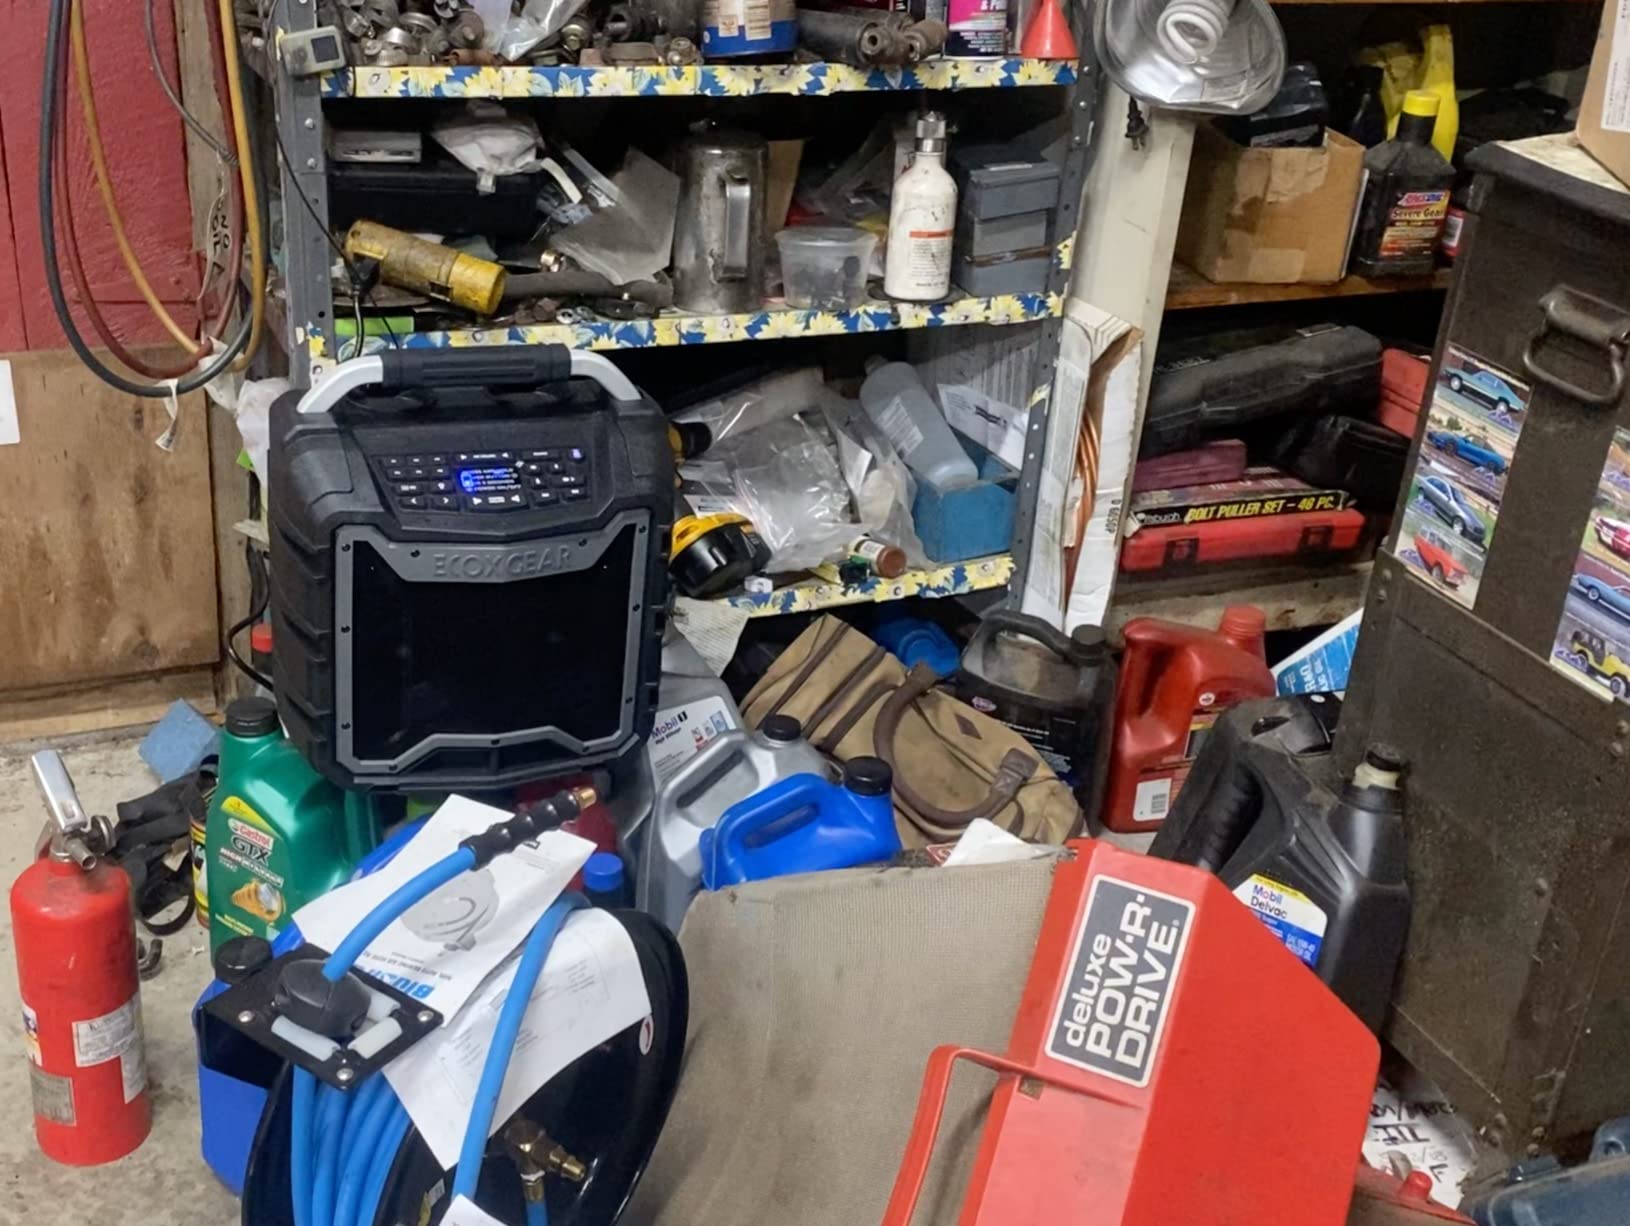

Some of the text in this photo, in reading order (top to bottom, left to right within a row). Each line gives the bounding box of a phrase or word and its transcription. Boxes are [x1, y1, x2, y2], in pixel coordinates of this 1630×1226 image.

[1392, 207, 1421, 219] Severe
[1184, 506, 1216, 524] BOLT
[1216, 501, 1260, 519] PULLER
[1261, 499, 1287, 514] SET
[432, 545, 572, 578] ECOXGEAR
[654, 715, 679, 738] Mobil
[238, 822, 272, 850] Castrol
[230, 833, 273, 867] GTX
[1250, 895, 1288, 919] Delvac
[1251, 884, 1283, 905] Mobil
[1063, 933, 1112, 1048] deluxe
[1114, 920, 1180, 1069] DRIVE
